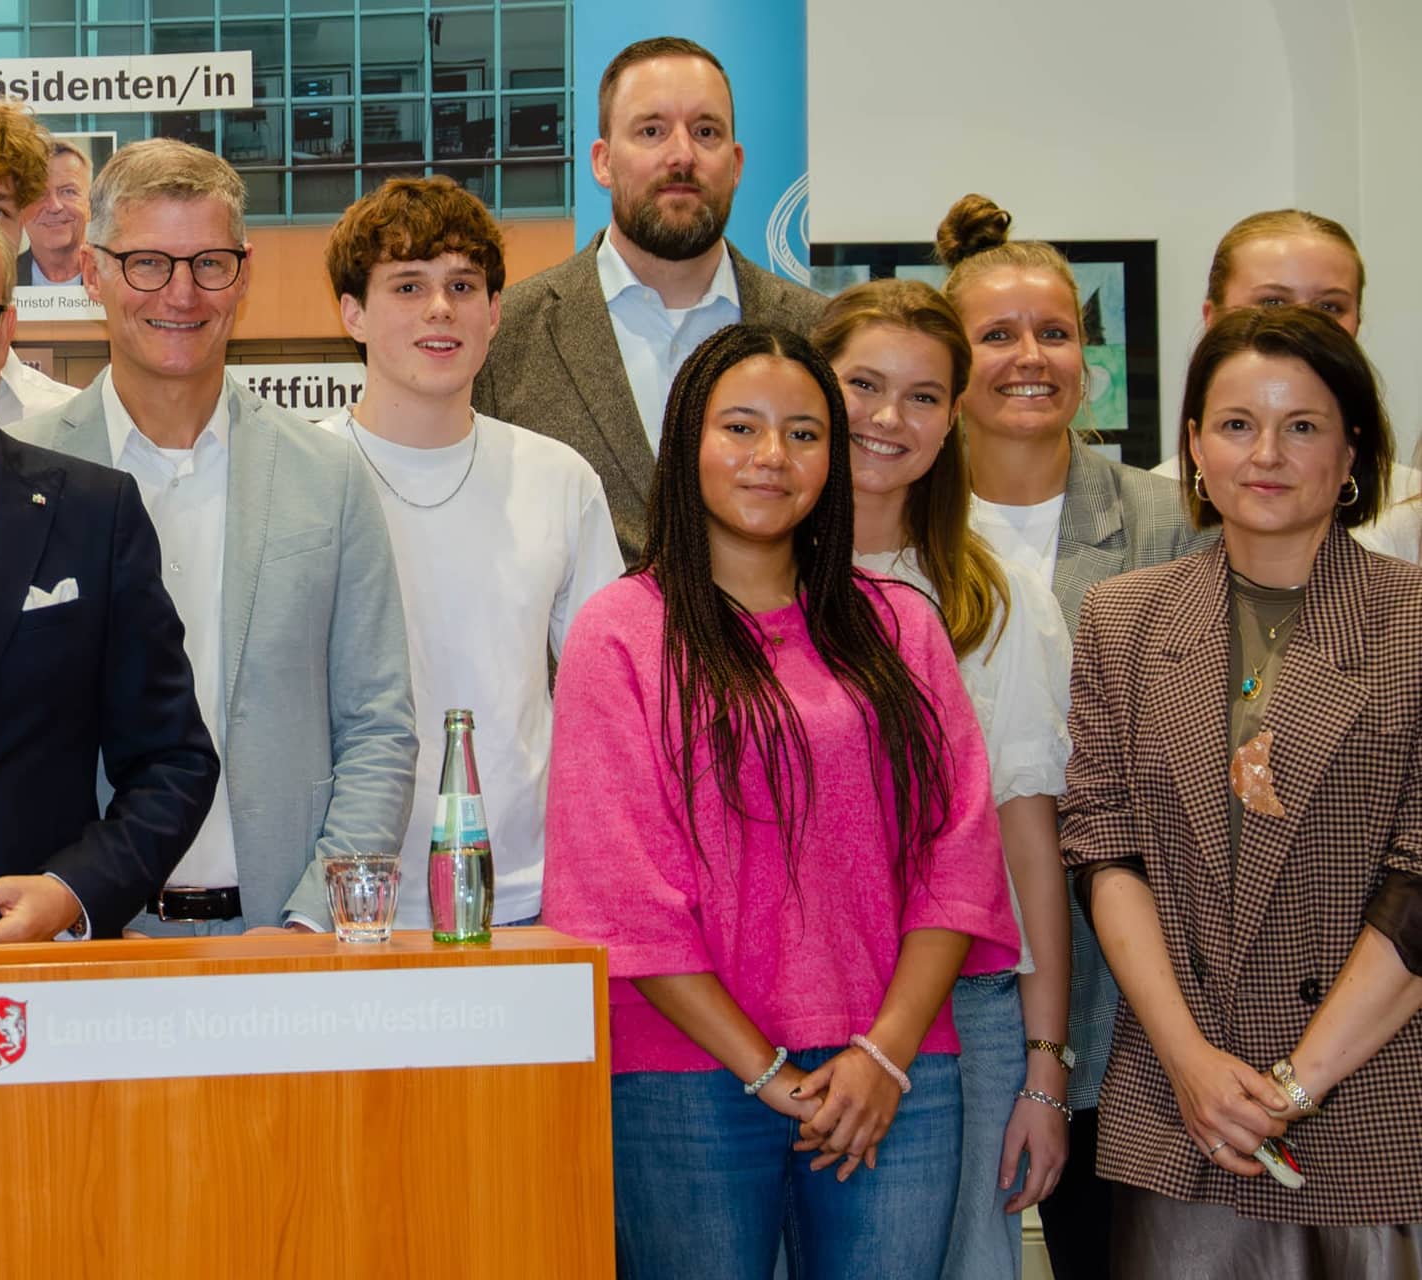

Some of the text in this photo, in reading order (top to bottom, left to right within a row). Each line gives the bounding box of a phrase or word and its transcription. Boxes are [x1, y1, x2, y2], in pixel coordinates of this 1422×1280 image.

[16, 296, 55, 309] hristof
[248, 376, 364, 409] iftführ
[46, 998, 506, 1049] Landtag Nordrhein-Westfalen
